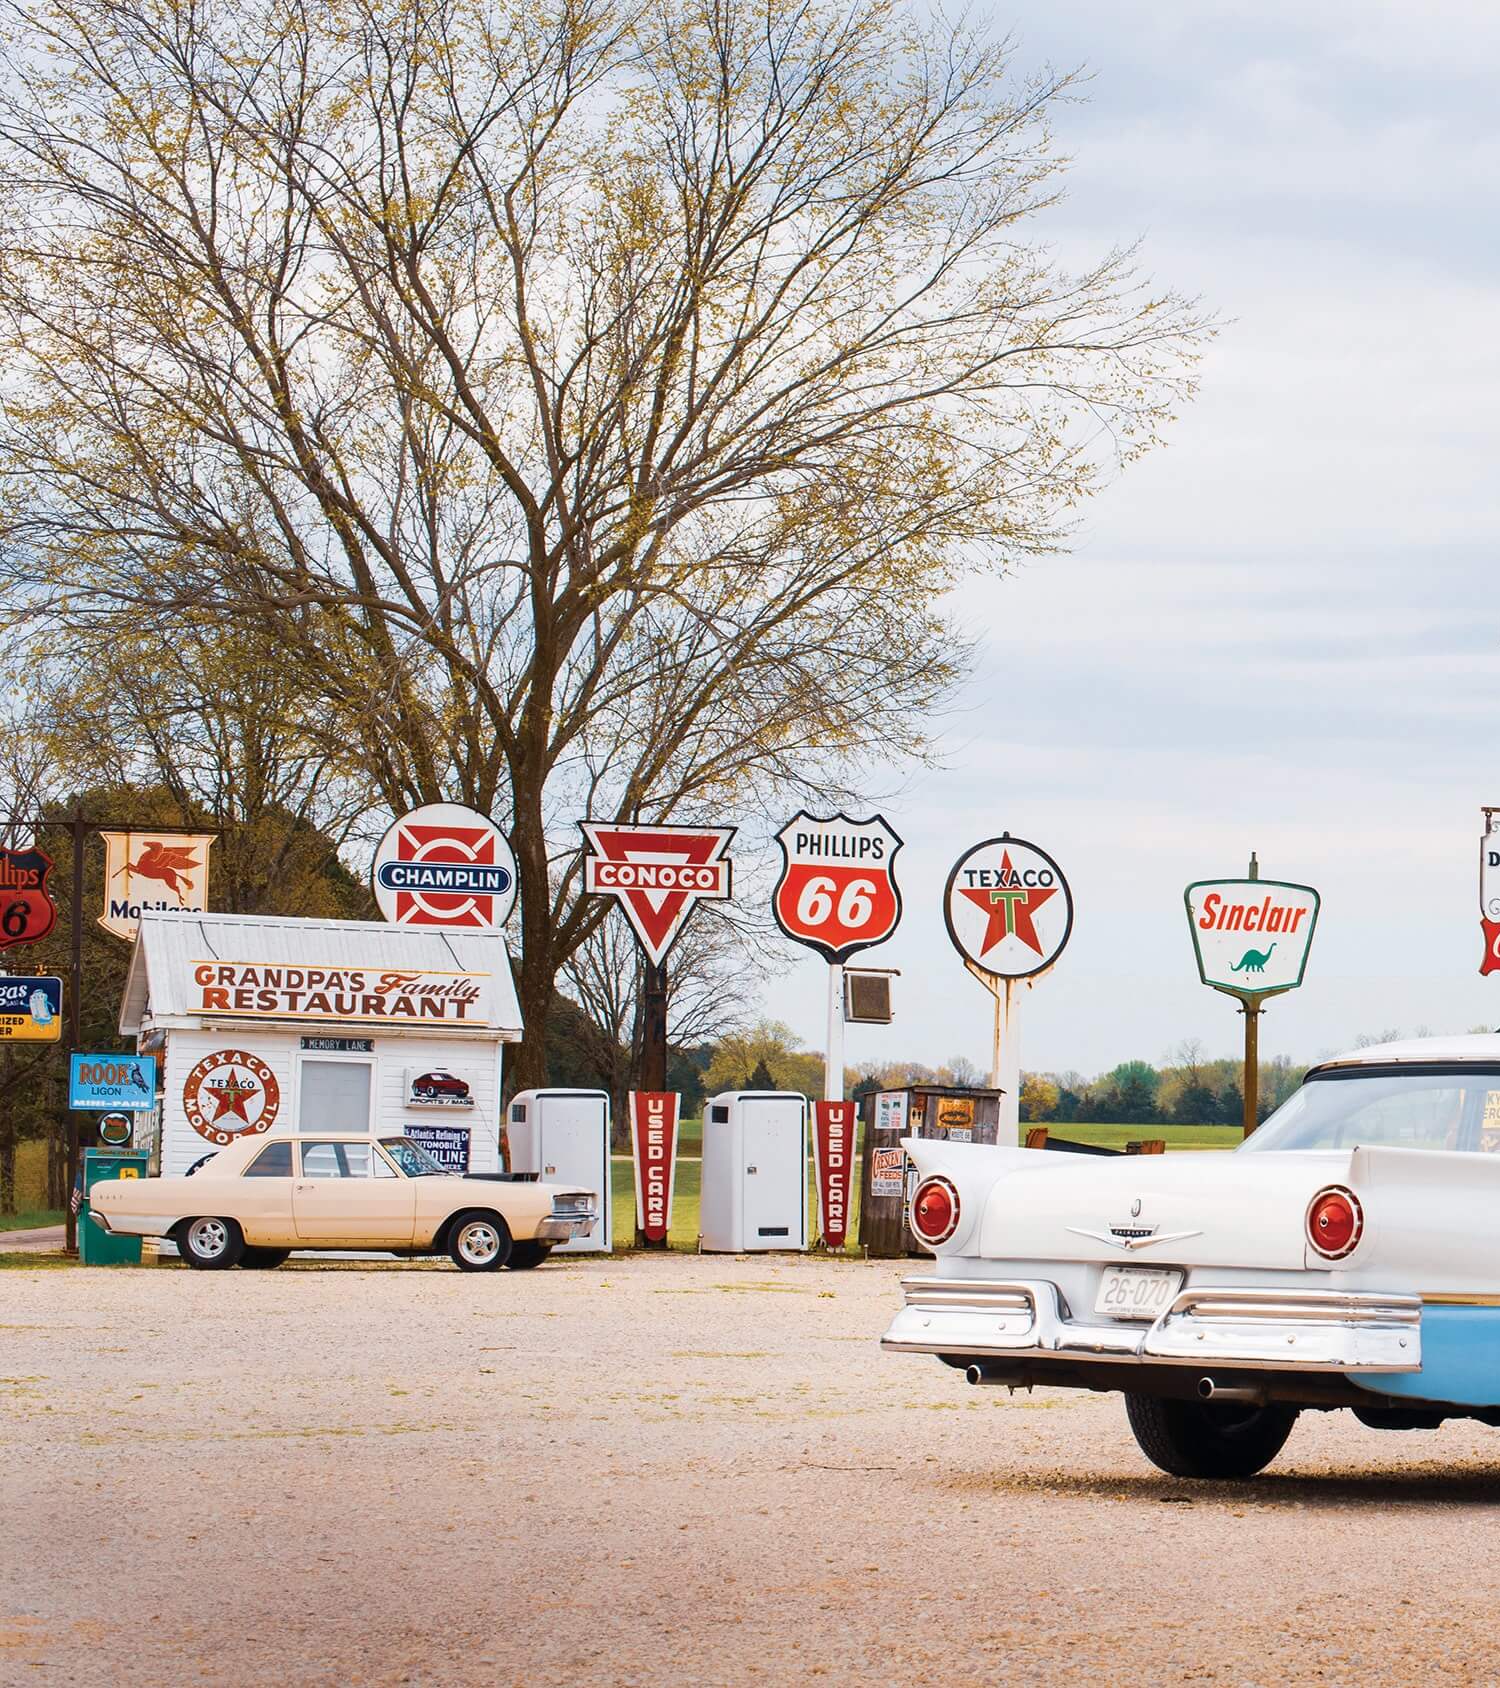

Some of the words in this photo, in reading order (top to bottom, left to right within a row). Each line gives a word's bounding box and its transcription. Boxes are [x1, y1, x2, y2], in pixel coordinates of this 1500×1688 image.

[796, 832, 884, 859] PHILLIPS
[391, 868, 499, 888] CHAMPLIN
[600, 865, 714, 889] CONOCO
[964, 869, 1054, 888] TEXACO
[797, 876, 877, 928] 66
[1200, 893, 1307, 934] Sinclair
[195, 965, 364, 992] GRANDPA'S
[374, 973, 480, 999] Family
[202, 987, 474, 1019] RESTAURANT
[309, 1040, 340, 1049] MEMORY
[346, 1041, 367, 1050] LANE
[79, 1063, 132, 1086] ROOK
[192, 1053, 271, 1080] TEXACO
[91, 1087, 121, 1096] LIGON
[210, 1079, 254, 1088] TEXACO
[73, 1099, 150, 1108] MINI-PARK
[256, 1103, 278, 1131] OIL
[410, 1128, 435, 1140] Atlantic
[436, 1130, 460, 1142] Refining
[648, 1100, 663, 1160] USED
[829, 1109, 843, 1167] USED
[417, 1140, 462, 1149] UTOMOBILE
[880, 1171, 902, 1179] FEEDS
[648, 1166, 663, 1227] CARS
[829, 1174, 843, 1232] CARS
[1104, 1278, 1171, 1305] 26-070
